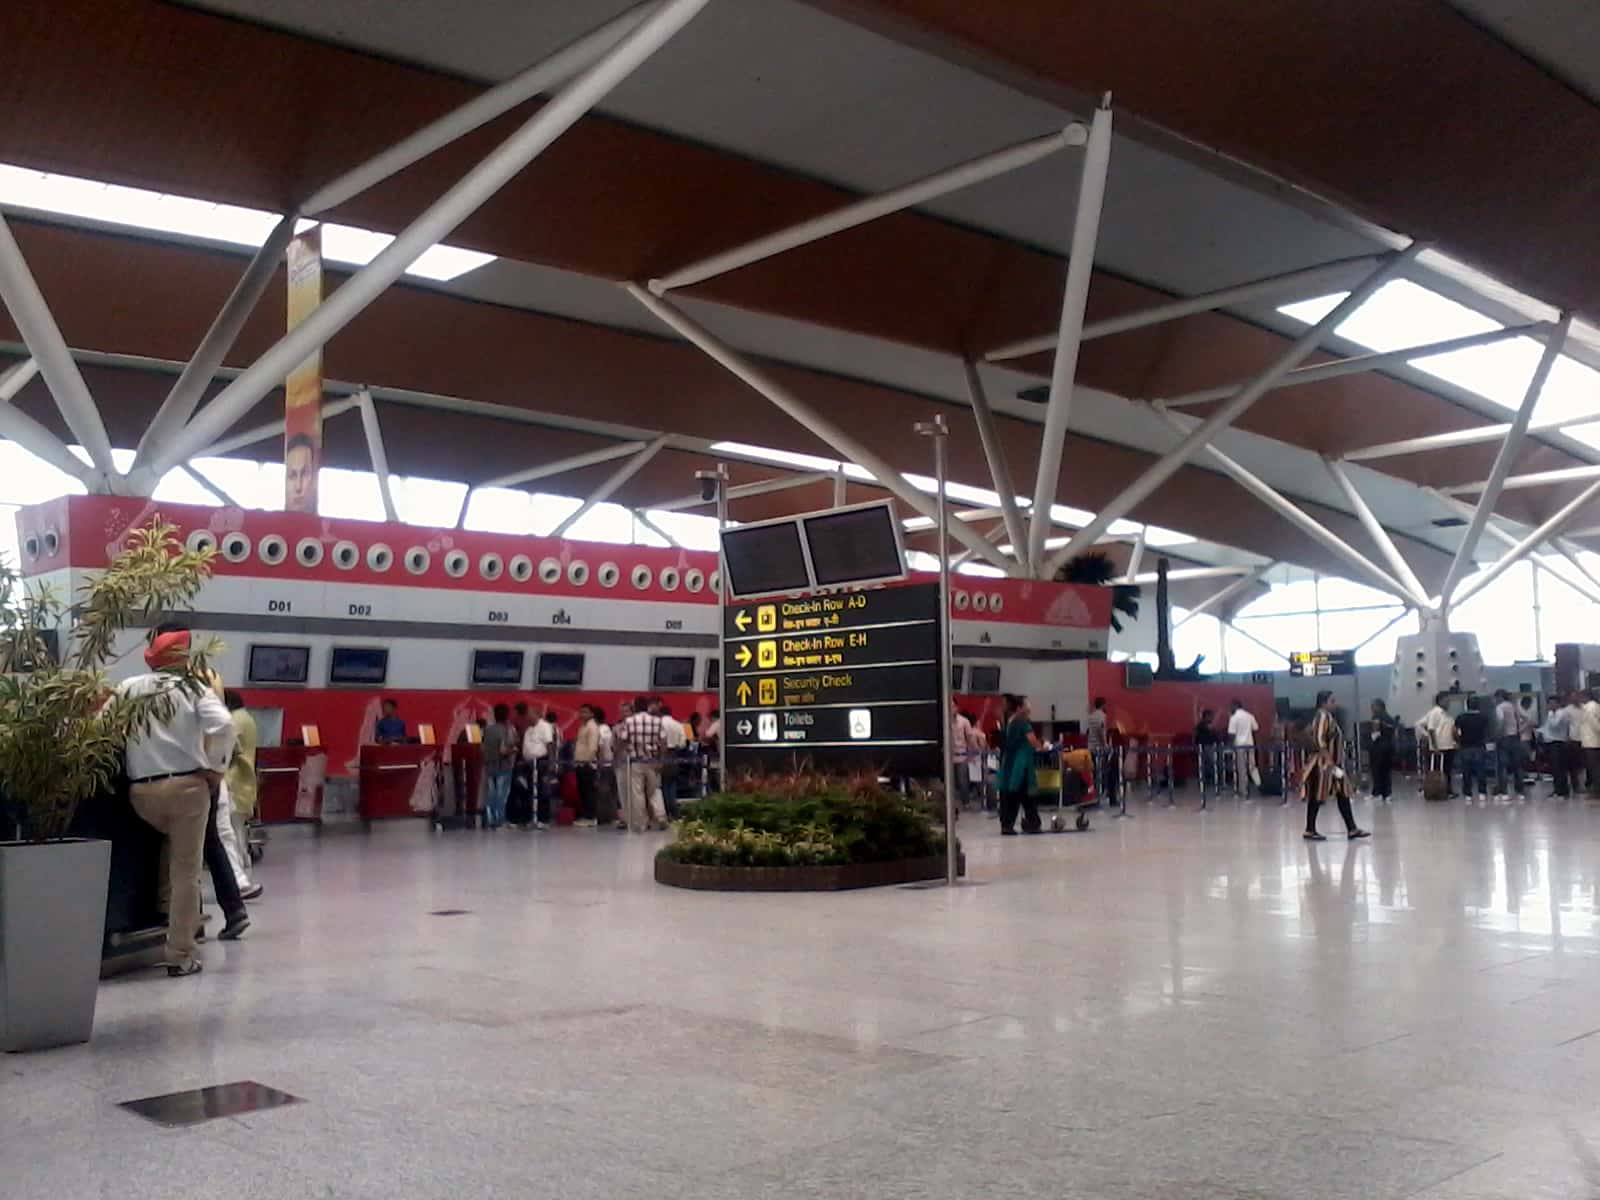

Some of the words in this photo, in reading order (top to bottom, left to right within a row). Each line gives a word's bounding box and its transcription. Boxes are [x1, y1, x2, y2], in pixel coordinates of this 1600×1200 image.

[268, 600, 292, 613] D01
[348, 604, 372, 617] D02
[782, 601, 821, 616] Check-In
[823, 598, 844, 611] Row
[848, 595, 866, 609] A-D
[488, 610, 509, 622] D03
[783, 637, 823, 652] Check-In
[824, 636, 845, 649] Row
[849, 632, 867, 647] E-H
[783, 676, 821, 690] Security
[822, 674, 853, 688] Check
[783, 711, 814, 726] Toilets
